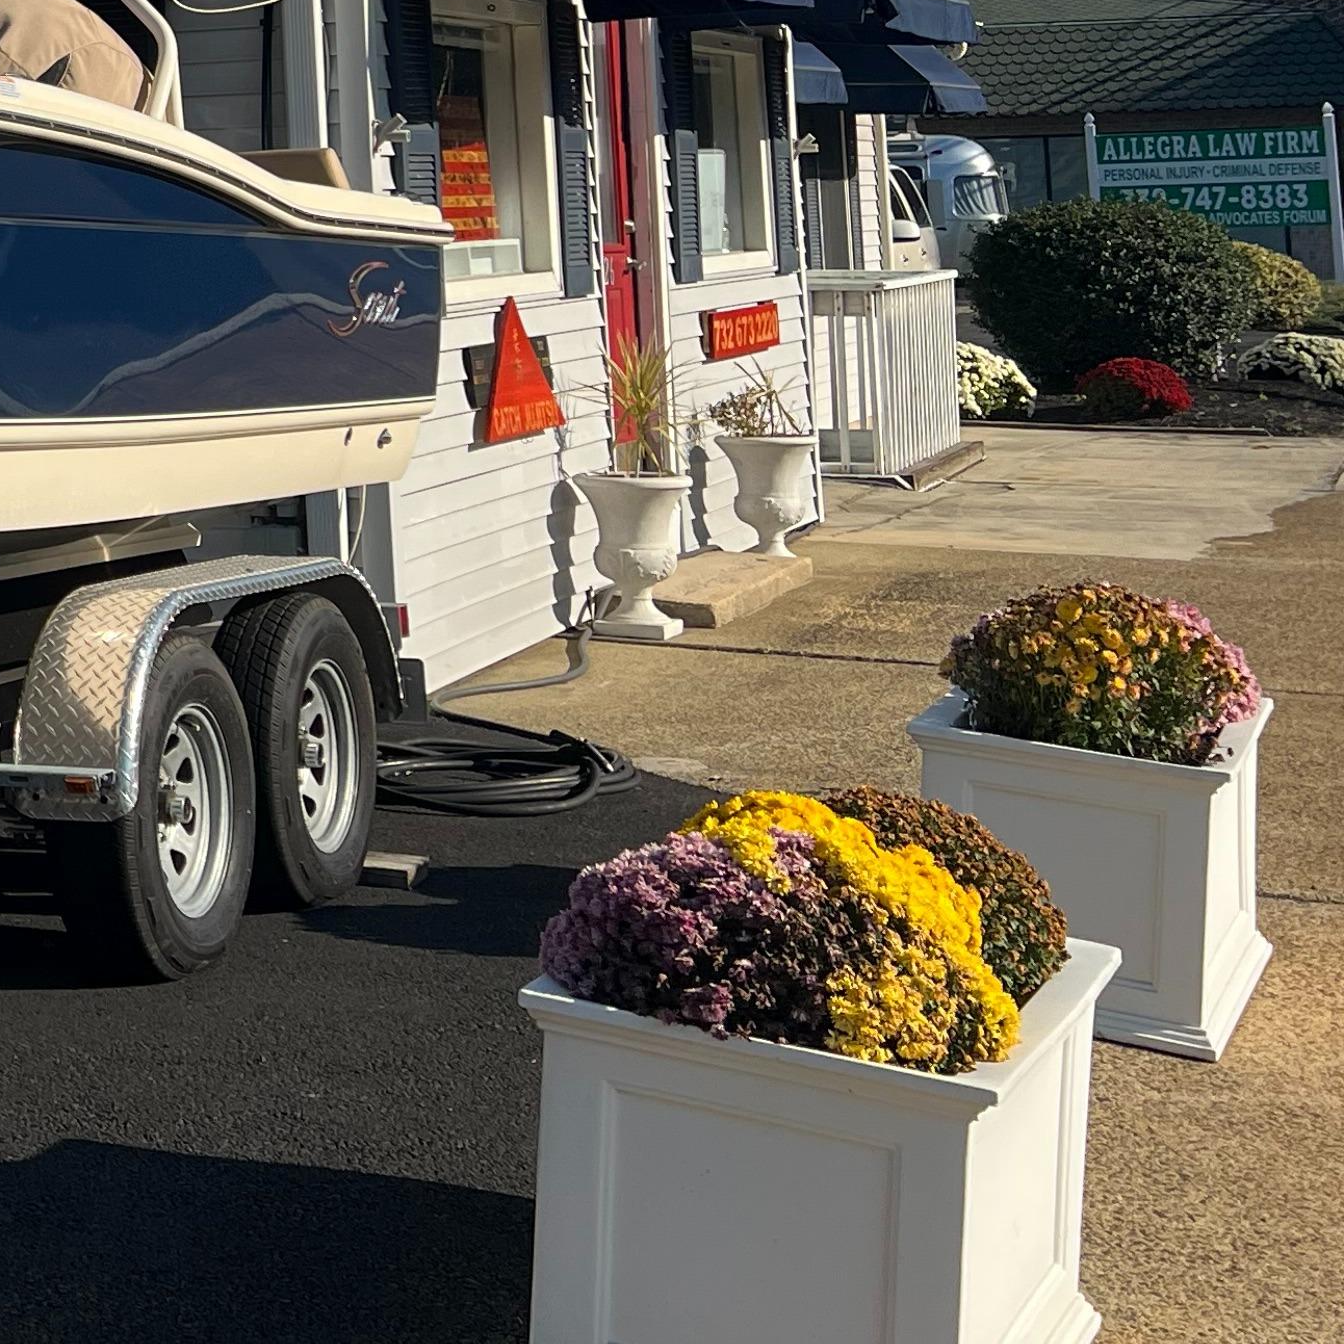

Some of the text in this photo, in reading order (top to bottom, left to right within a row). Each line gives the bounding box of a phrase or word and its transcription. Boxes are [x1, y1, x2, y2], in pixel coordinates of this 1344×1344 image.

[1103, 130, 1320, 160] ALLEGRA LAW FIRM
[1103, 161, 1321, 182] PERSONAL INJURY CRIMINAL DEFENSE
[1208, 210, 1280, 226] ADVOCATES
[1283, 209, 1327, 224] FORUM
[713, 318, 735, 352] 732
[735, 314, 755, 347] 673
